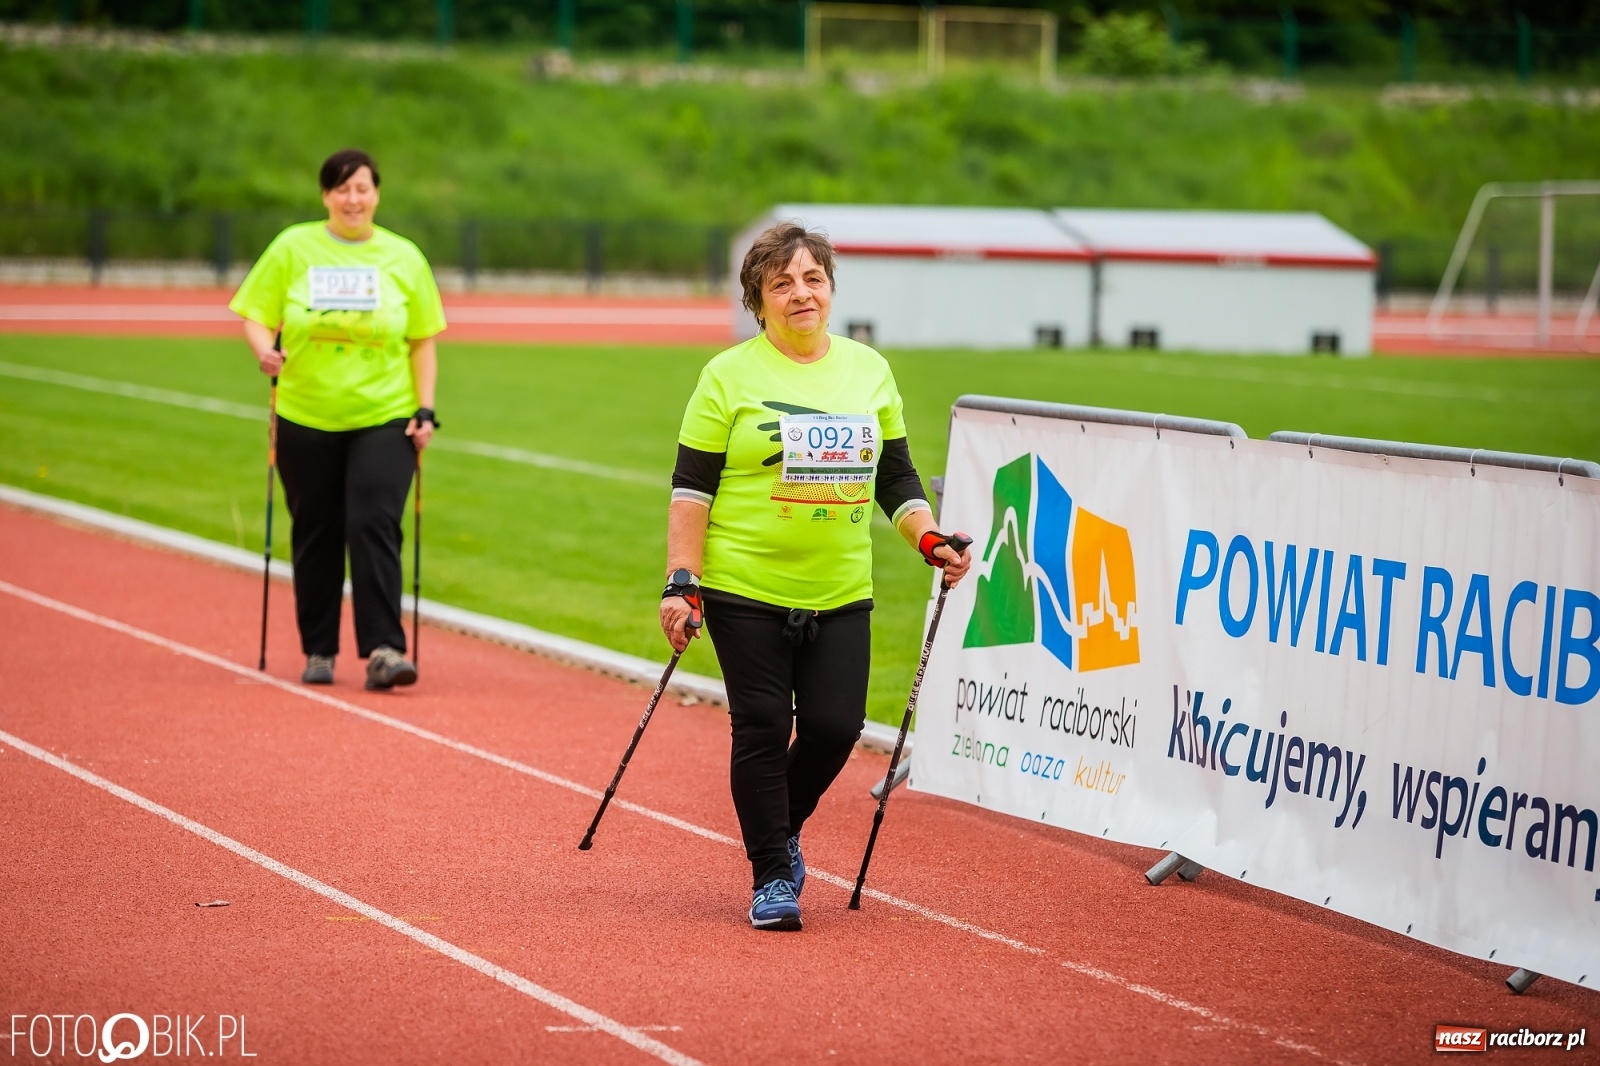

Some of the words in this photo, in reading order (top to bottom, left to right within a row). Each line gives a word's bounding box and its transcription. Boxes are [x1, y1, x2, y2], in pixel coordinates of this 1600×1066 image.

[808, 426, 854, 449] 092
[862, 426, 873, 439] R
[1175, 529, 1407, 666] POWIAT
[1415, 565, 1600, 705] RACIB
[955, 672, 1028, 723] powiat
[1039, 687, 1138, 748] raciborski
[952, 728, 1010, 768] zielona
[1020, 751, 1065, 780] oaza
[1074, 755, 1126, 795] kultur
[1167, 684, 1367, 830] kibicujemy,
[1392, 757, 1600, 901] wspieram
